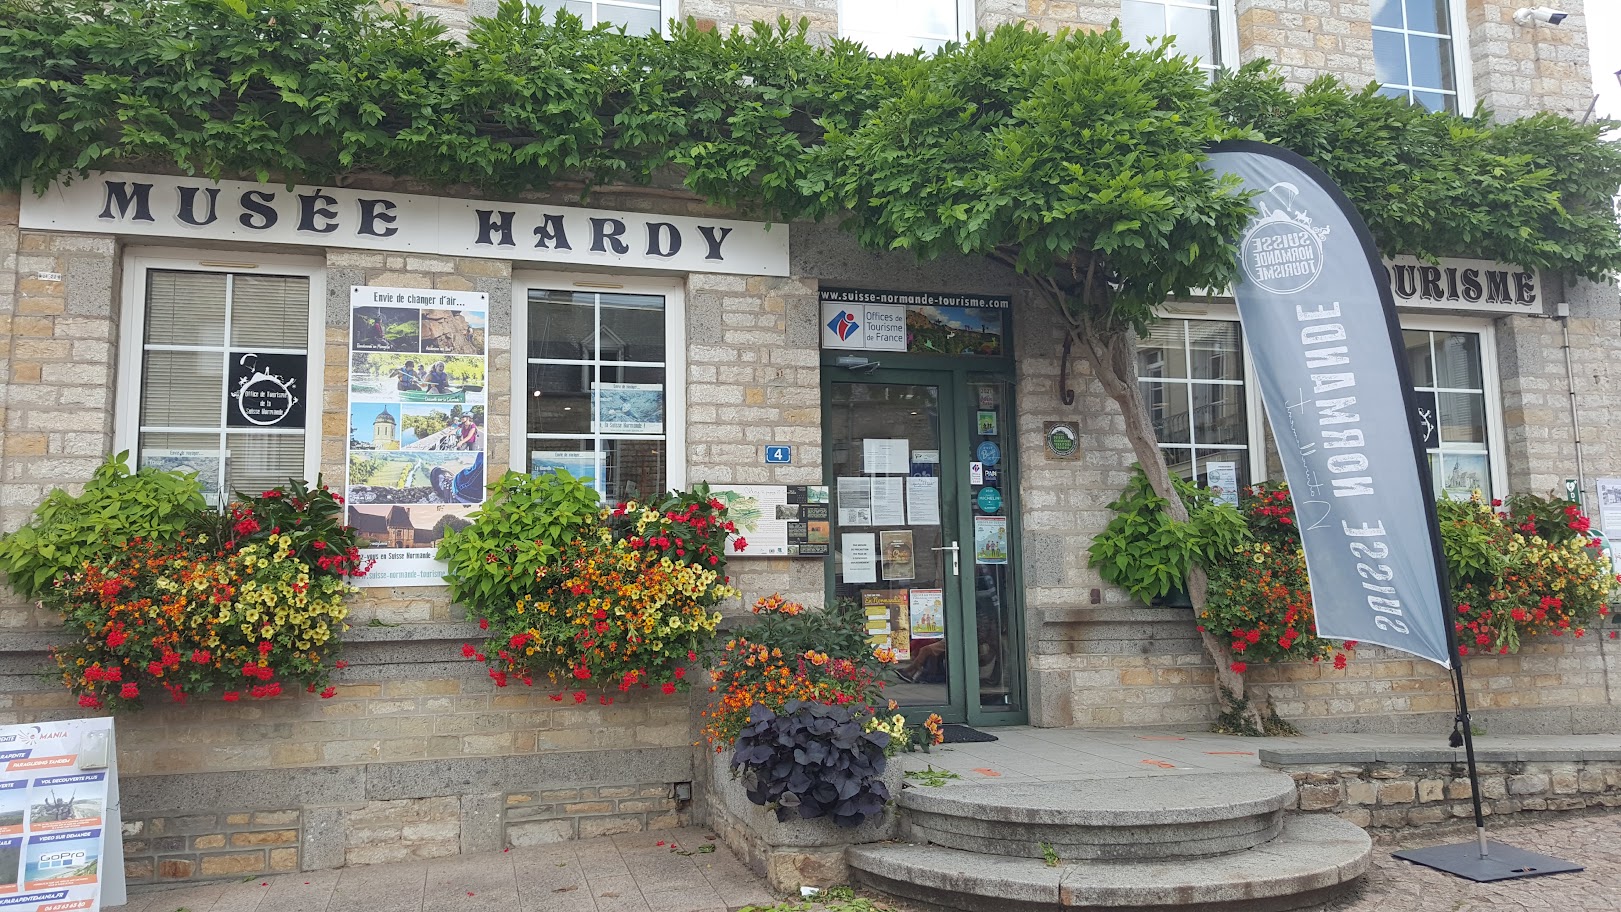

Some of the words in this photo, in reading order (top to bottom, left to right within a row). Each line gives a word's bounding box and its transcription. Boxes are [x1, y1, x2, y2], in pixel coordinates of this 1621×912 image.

[98, 180, 399, 237] MUSÉE
[475, 209, 733, 261] HARDY
[1382, 264, 1537, 306] URISME
[374, 292, 394, 303] Envie
[396, 293, 404, 304] de
[407, 294, 436, 306] changer
[439, 294, 465, 306] d'air...
[866, 312, 893, 322] Offices
[866, 322, 902, 332] Tourisme
[876, 334, 903, 342] France
[774, 448, 783, 460] 4
[41, 852, 84, 862] GoPro
